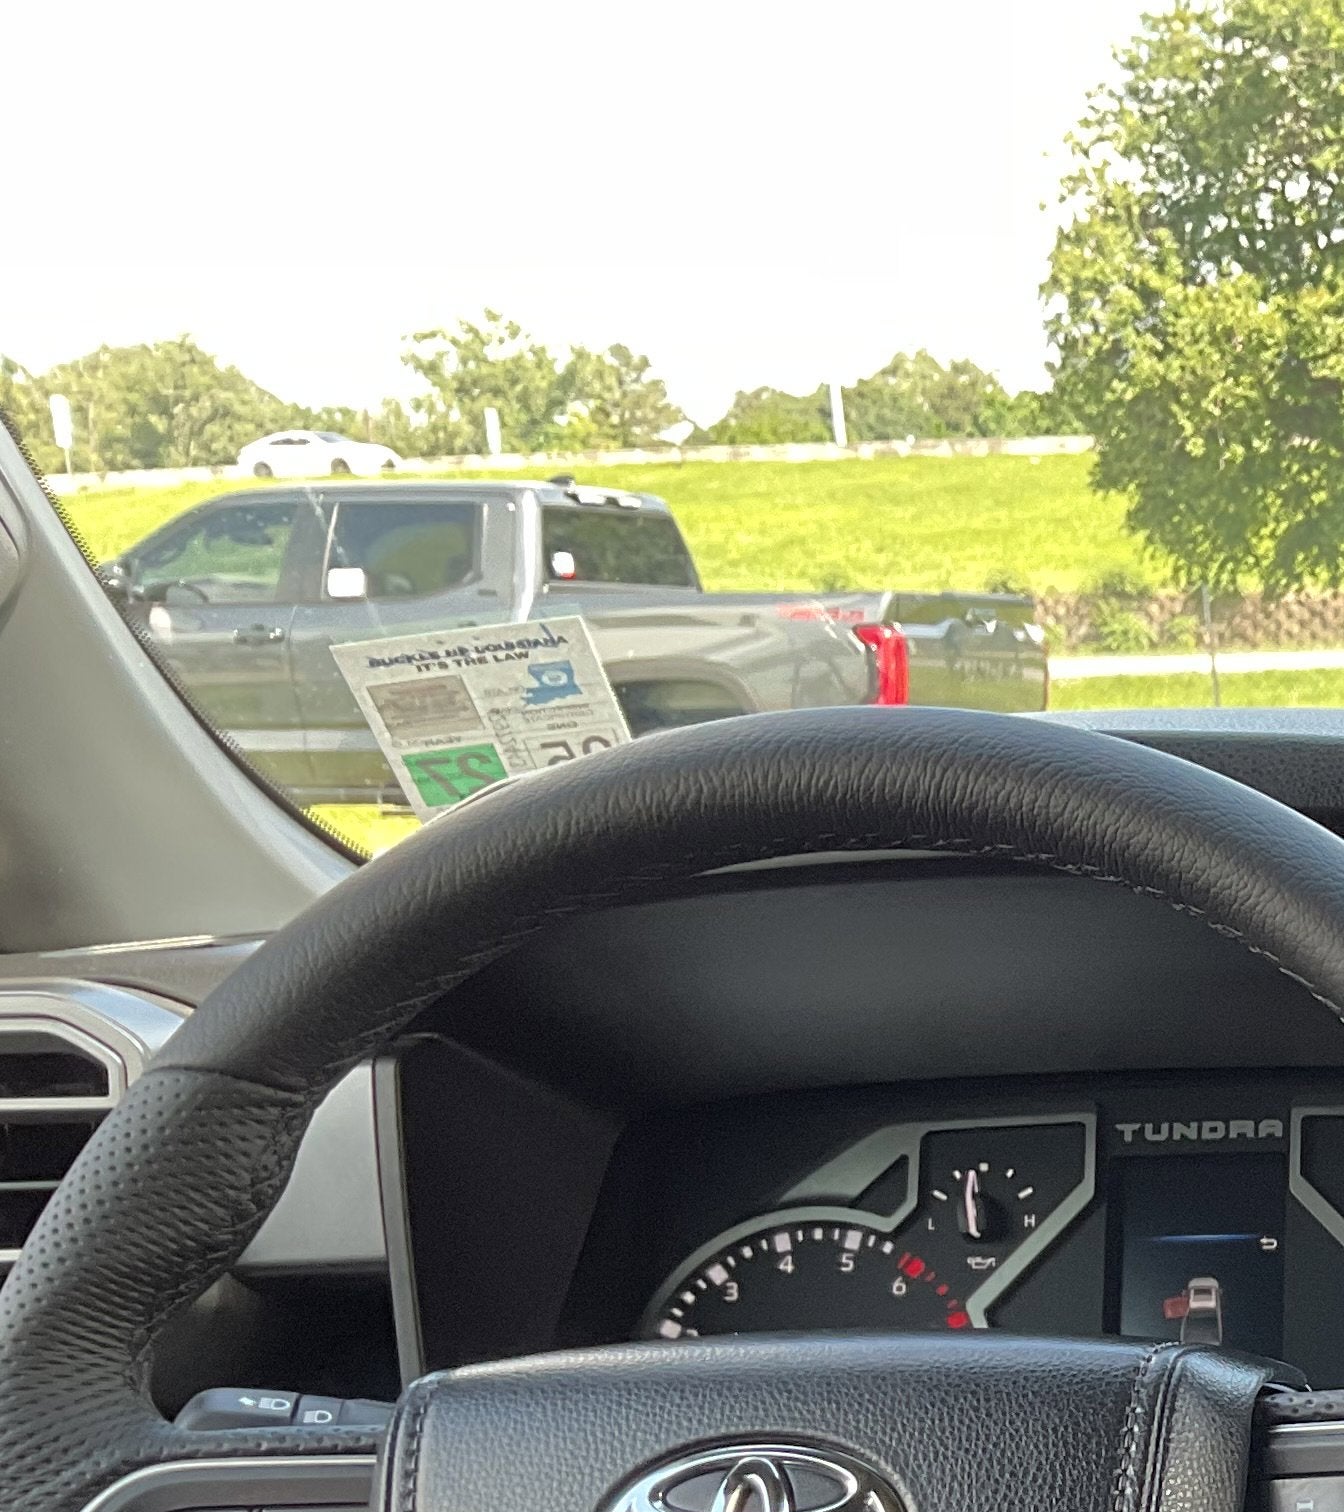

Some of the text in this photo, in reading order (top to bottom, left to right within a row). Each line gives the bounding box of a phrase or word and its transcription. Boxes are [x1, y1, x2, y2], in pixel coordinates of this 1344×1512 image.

[368, 649, 441, 669] BUCKLE
[415, 650, 529, 673] IT'S THE LAW
[1115, 1118, 1283, 1142] TUNDRA
[927, 1218, 936, 1232] L
[1023, 1213, 1036, 1229] H
[778, 1253, 795, 1275] 4
[840, 1252, 856, 1273] 5
[723, 1281, 739, 1303] 3
[891, 1276, 907, 1297] 6
